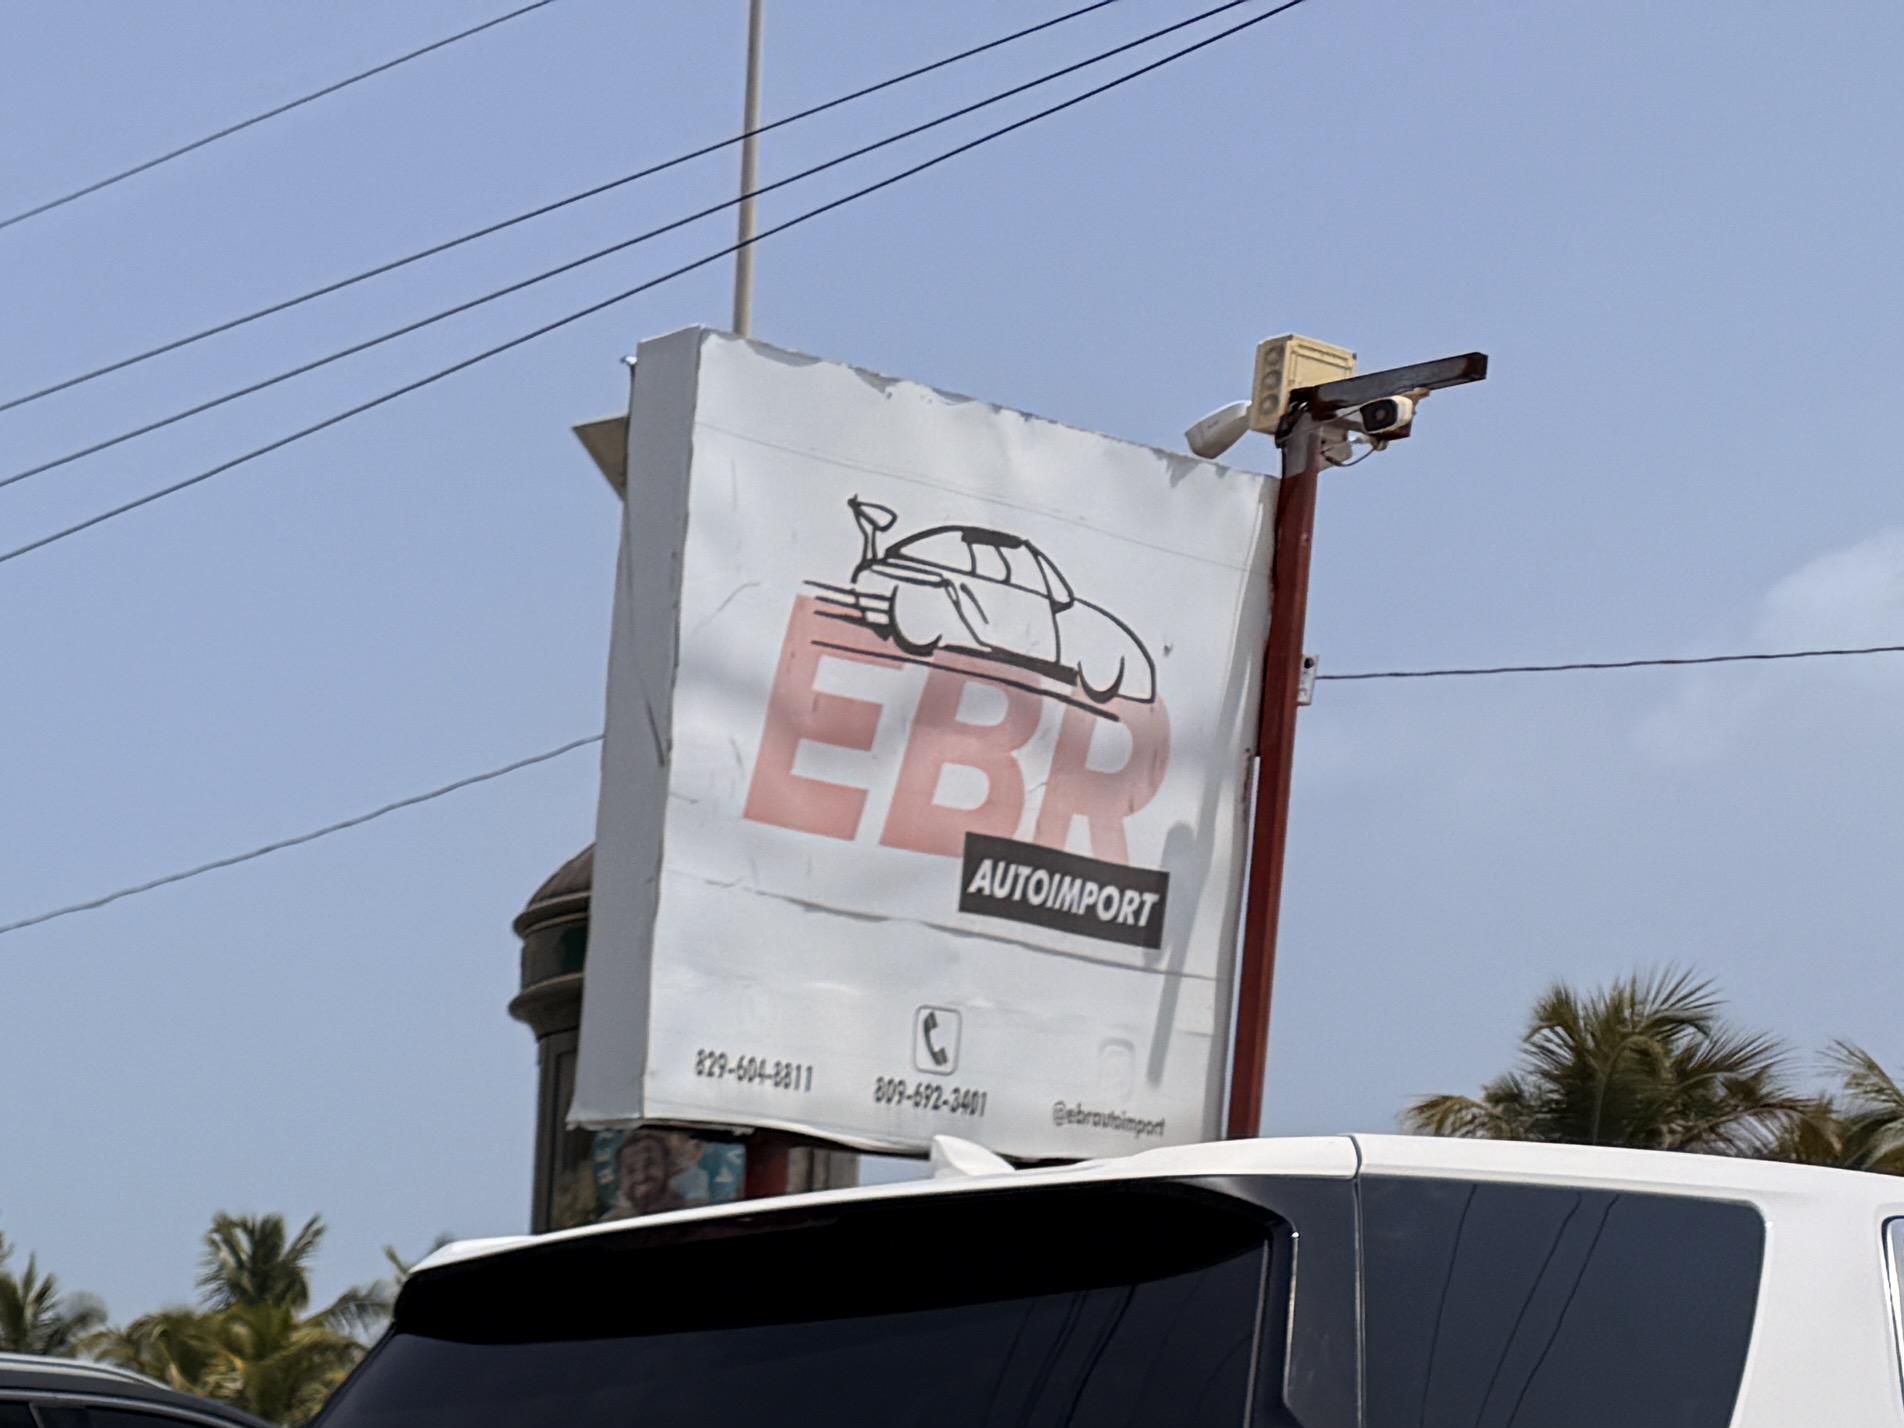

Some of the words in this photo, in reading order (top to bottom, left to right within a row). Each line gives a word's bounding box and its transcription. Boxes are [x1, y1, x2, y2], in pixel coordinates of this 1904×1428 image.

[743, 594, 1171, 866] EBR
[966, 859, 1160, 928] AUTOIMPORT
[695, 1048, 813, 1092] 829-604-8811
[874, 1076, 987, 1117] 809-692-3401
[1053, 1100, 1166, 1139] @ebrautoimport
